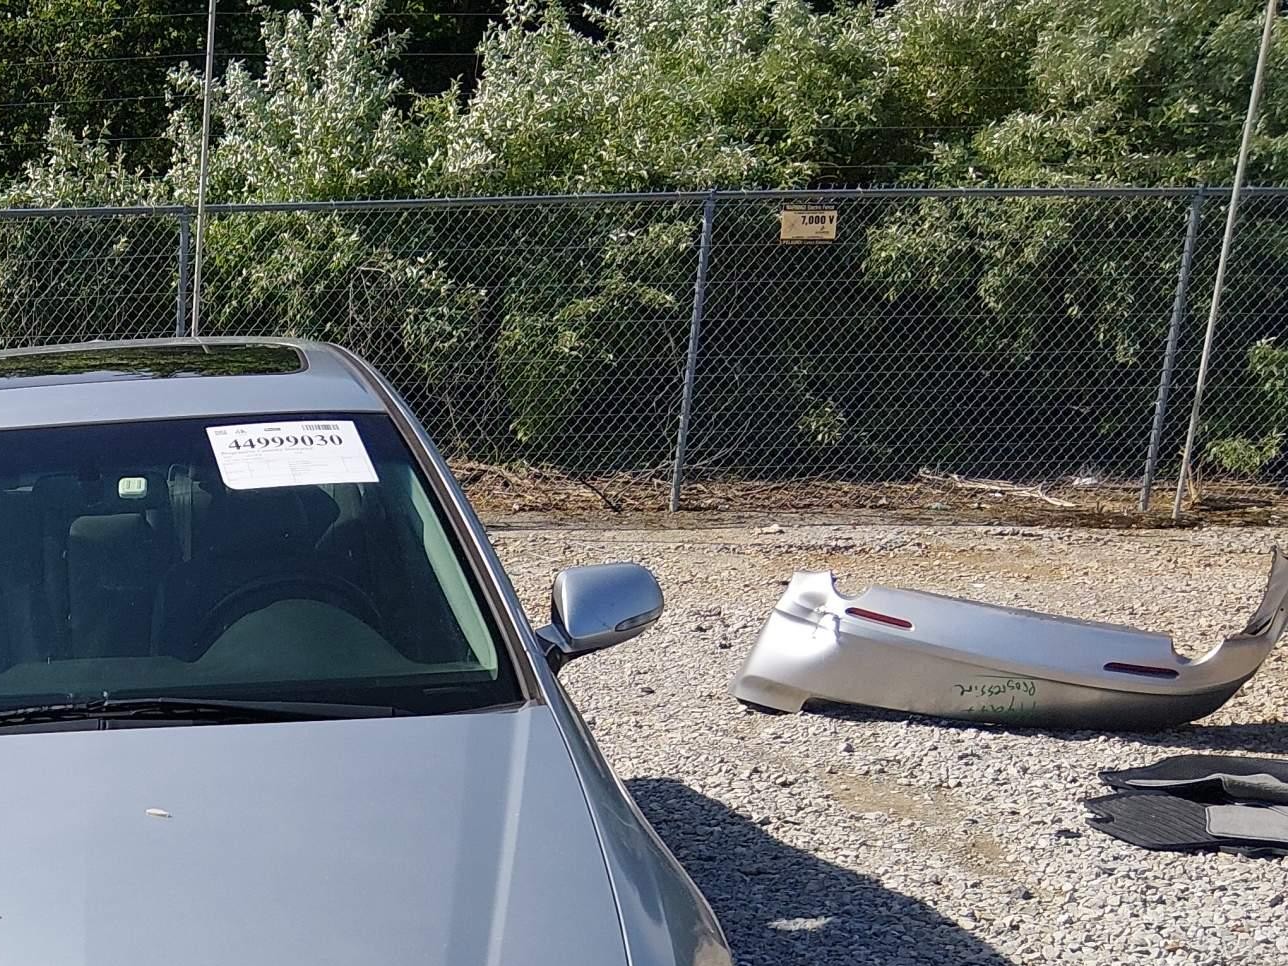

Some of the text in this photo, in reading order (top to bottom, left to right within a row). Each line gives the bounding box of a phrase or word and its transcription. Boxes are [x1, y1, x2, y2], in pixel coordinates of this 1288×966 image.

[801, 215, 834, 226] 7,000 V
[228, 434, 343, 450] 44999030
